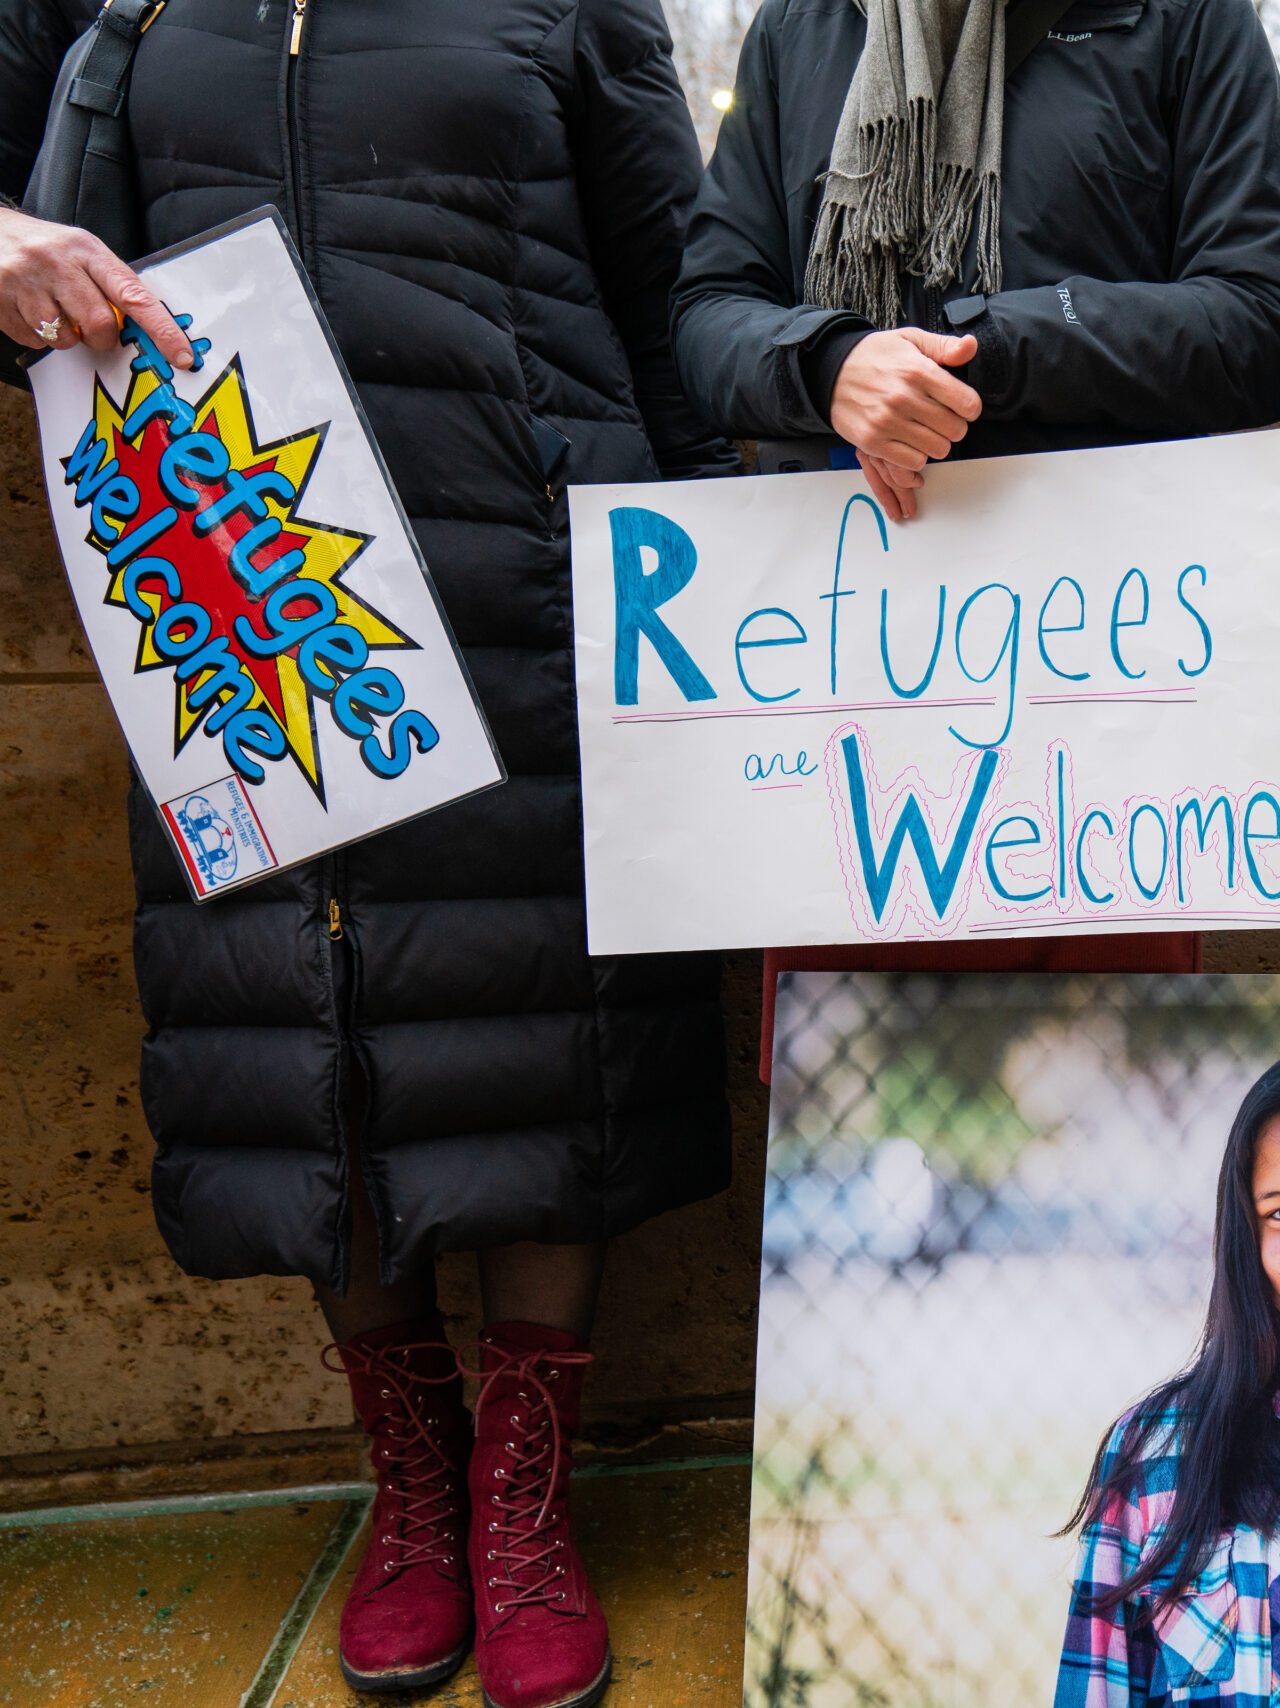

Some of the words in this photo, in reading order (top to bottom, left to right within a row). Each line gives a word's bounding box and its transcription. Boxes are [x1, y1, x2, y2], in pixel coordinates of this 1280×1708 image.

[1047, 30, 1092, 43] L.L.Bean
[62, 418, 288, 784] welcome
[608, 493, 1213, 750] Refugees
[744, 748, 818, 782] are
[226, 780, 245, 812] REFUGEE
[243, 818, 269, 867] IMMIGRATION
[228, 807, 251, 848] MINISTRIES
